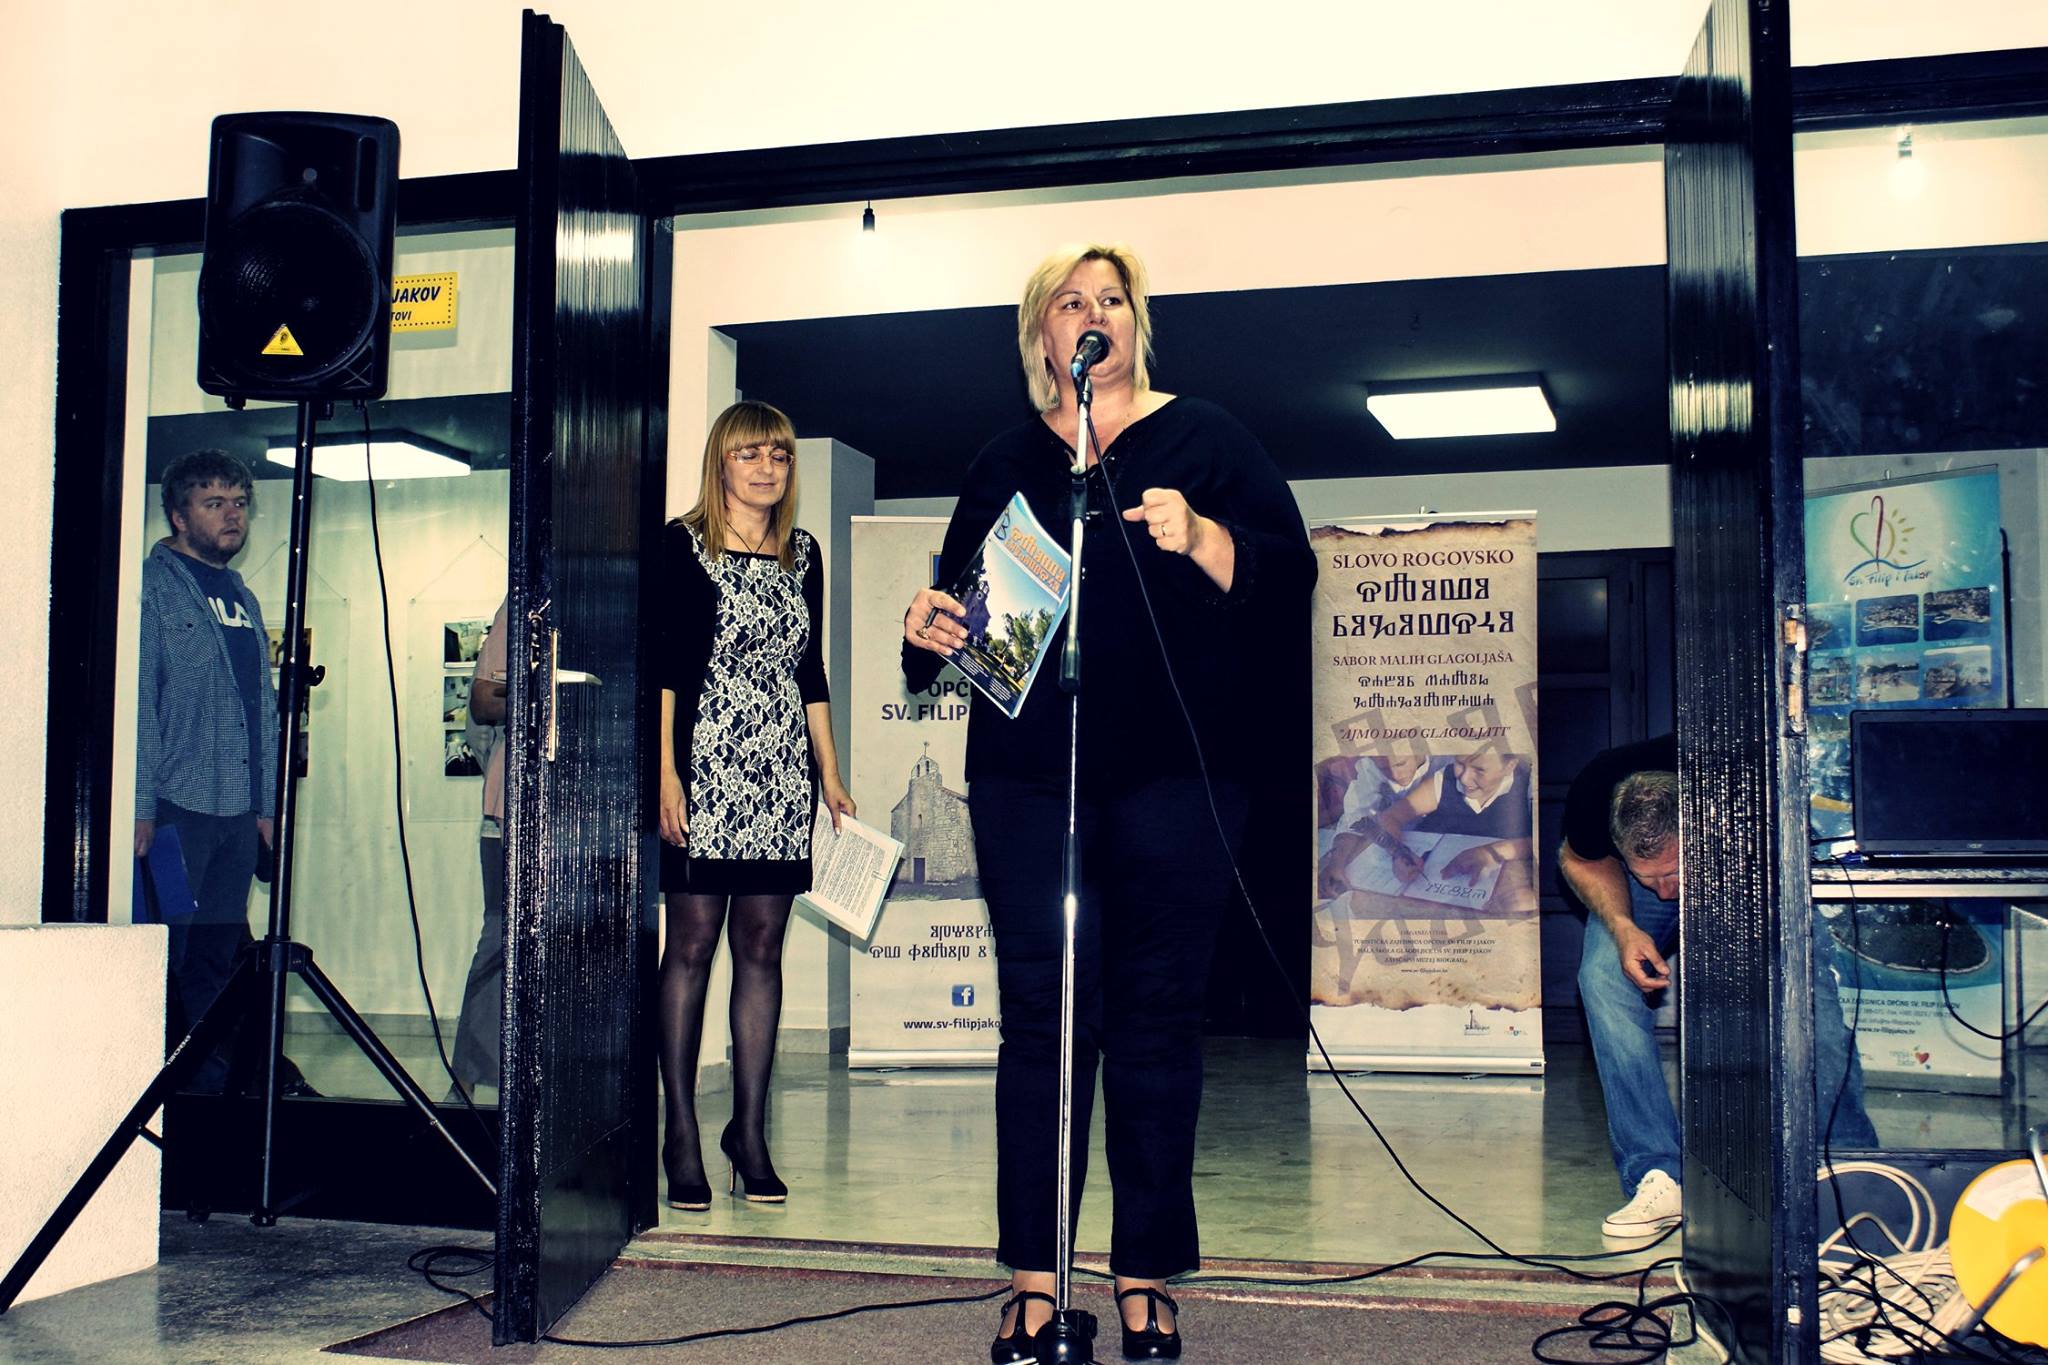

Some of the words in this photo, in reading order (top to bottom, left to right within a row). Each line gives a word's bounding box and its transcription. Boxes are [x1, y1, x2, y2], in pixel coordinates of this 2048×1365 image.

[392, 285, 442, 303] JAKOV
[391, 310, 412, 321] TOVI
[1333, 553, 1398, 569] SLOVO
[1402, 549, 1514, 567] ROGOVSKO
[208, 597, 254, 628] ILA
[1333, 655, 1377, 667] SABOR
[1379, 654, 1424, 665] MALIH
[1427, 650, 1514, 666] GLAGOLJAŠA
[928, 677, 968, 697] OPĆ
[881, 704, 911, 720] SV.
[918, 704, 968, 720] FILIP
[904, 1018, 1001, 1031] www.sv-filipjako
